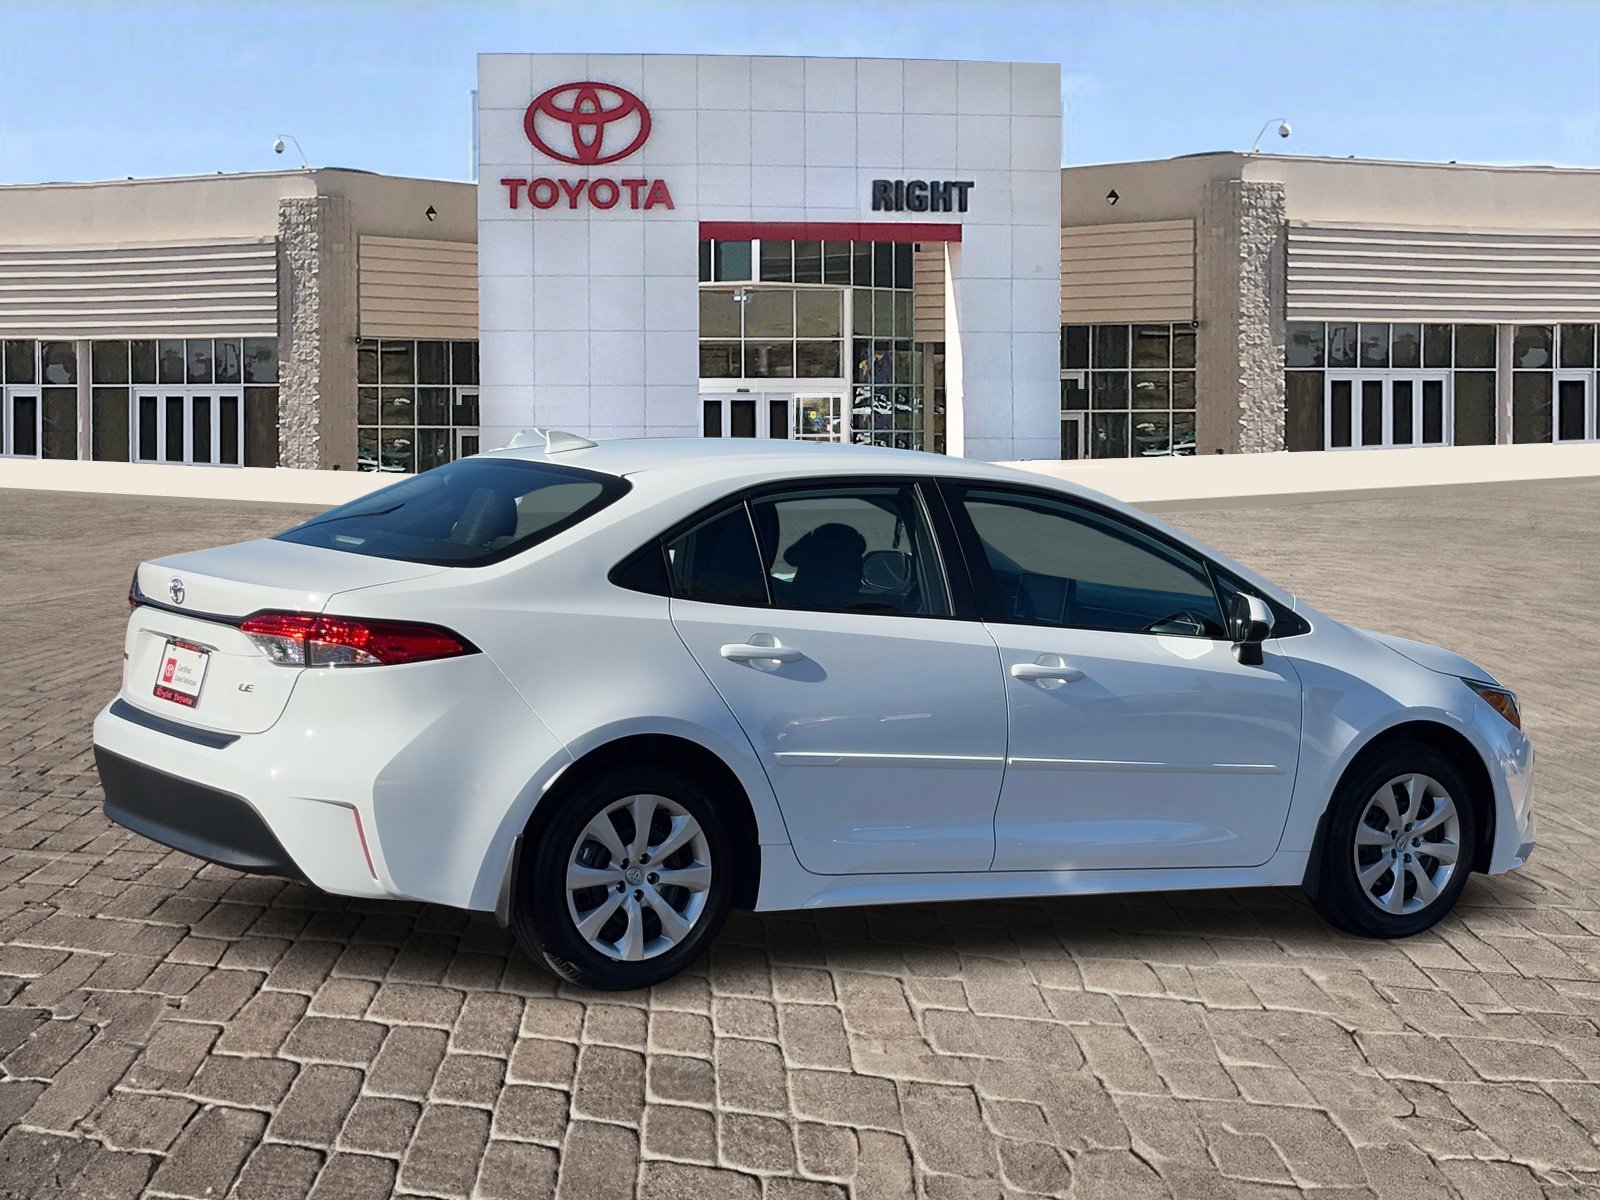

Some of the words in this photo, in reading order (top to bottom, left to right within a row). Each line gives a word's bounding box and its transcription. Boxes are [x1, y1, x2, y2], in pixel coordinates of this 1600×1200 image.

[500, 179, 675, 210] TOYOTA
[872, 180, 975, 212] RIGHT
[238, 683, 255, 693] LE
